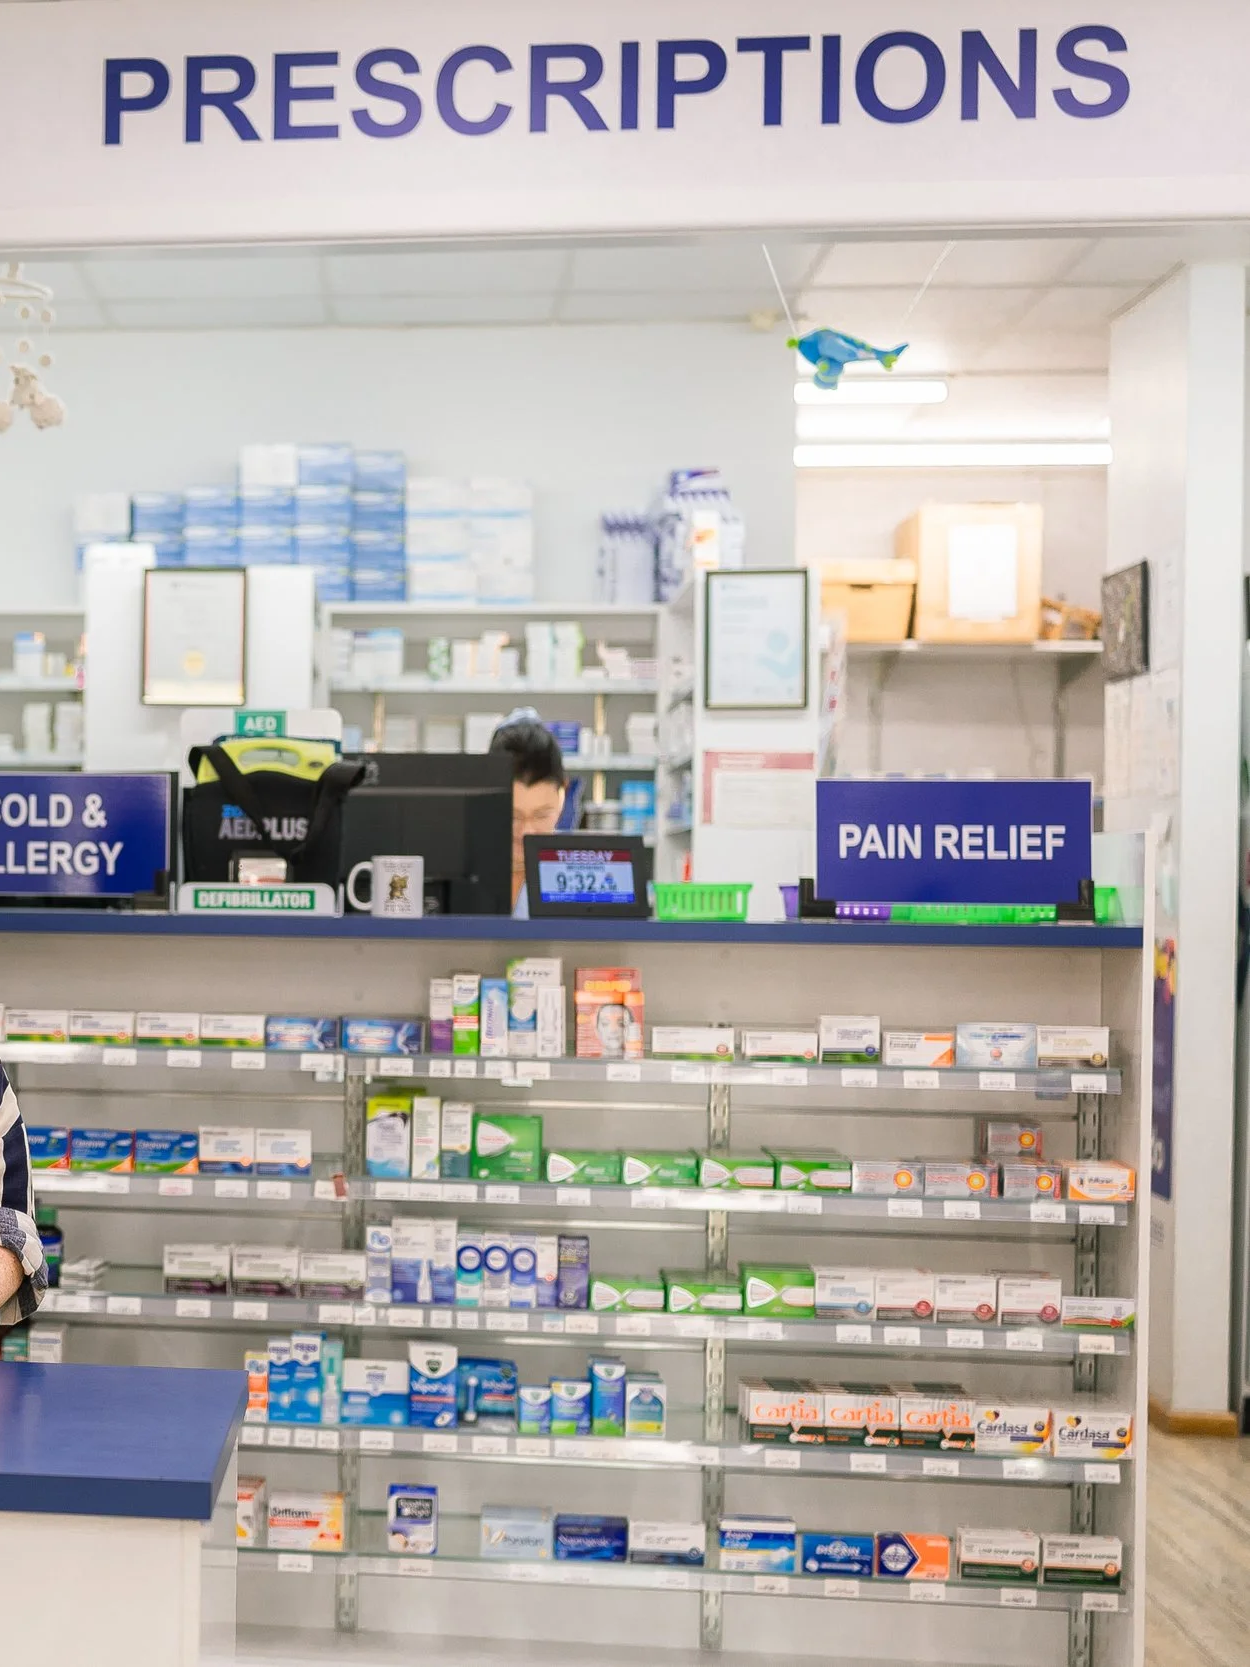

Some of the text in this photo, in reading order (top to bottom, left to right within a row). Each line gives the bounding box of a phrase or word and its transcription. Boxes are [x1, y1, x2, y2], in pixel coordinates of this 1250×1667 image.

[100, 22, 1133, 146] PRESCRIPTIONS
[243, 717, 277, 731] AED
[81, 793, 108, 829] &
[838, 823, 1066, 860] PAIN RELIEF
[556, 850, 614, 862] TUESDAY
[556, 871, 597, 892] 9:32
[197, 891, 312, 909] DEFIBRILLATOR
[977, 1421, 1028, 1434] Cardasa
[1058, 1427, 1110, 1441] Cardasa
